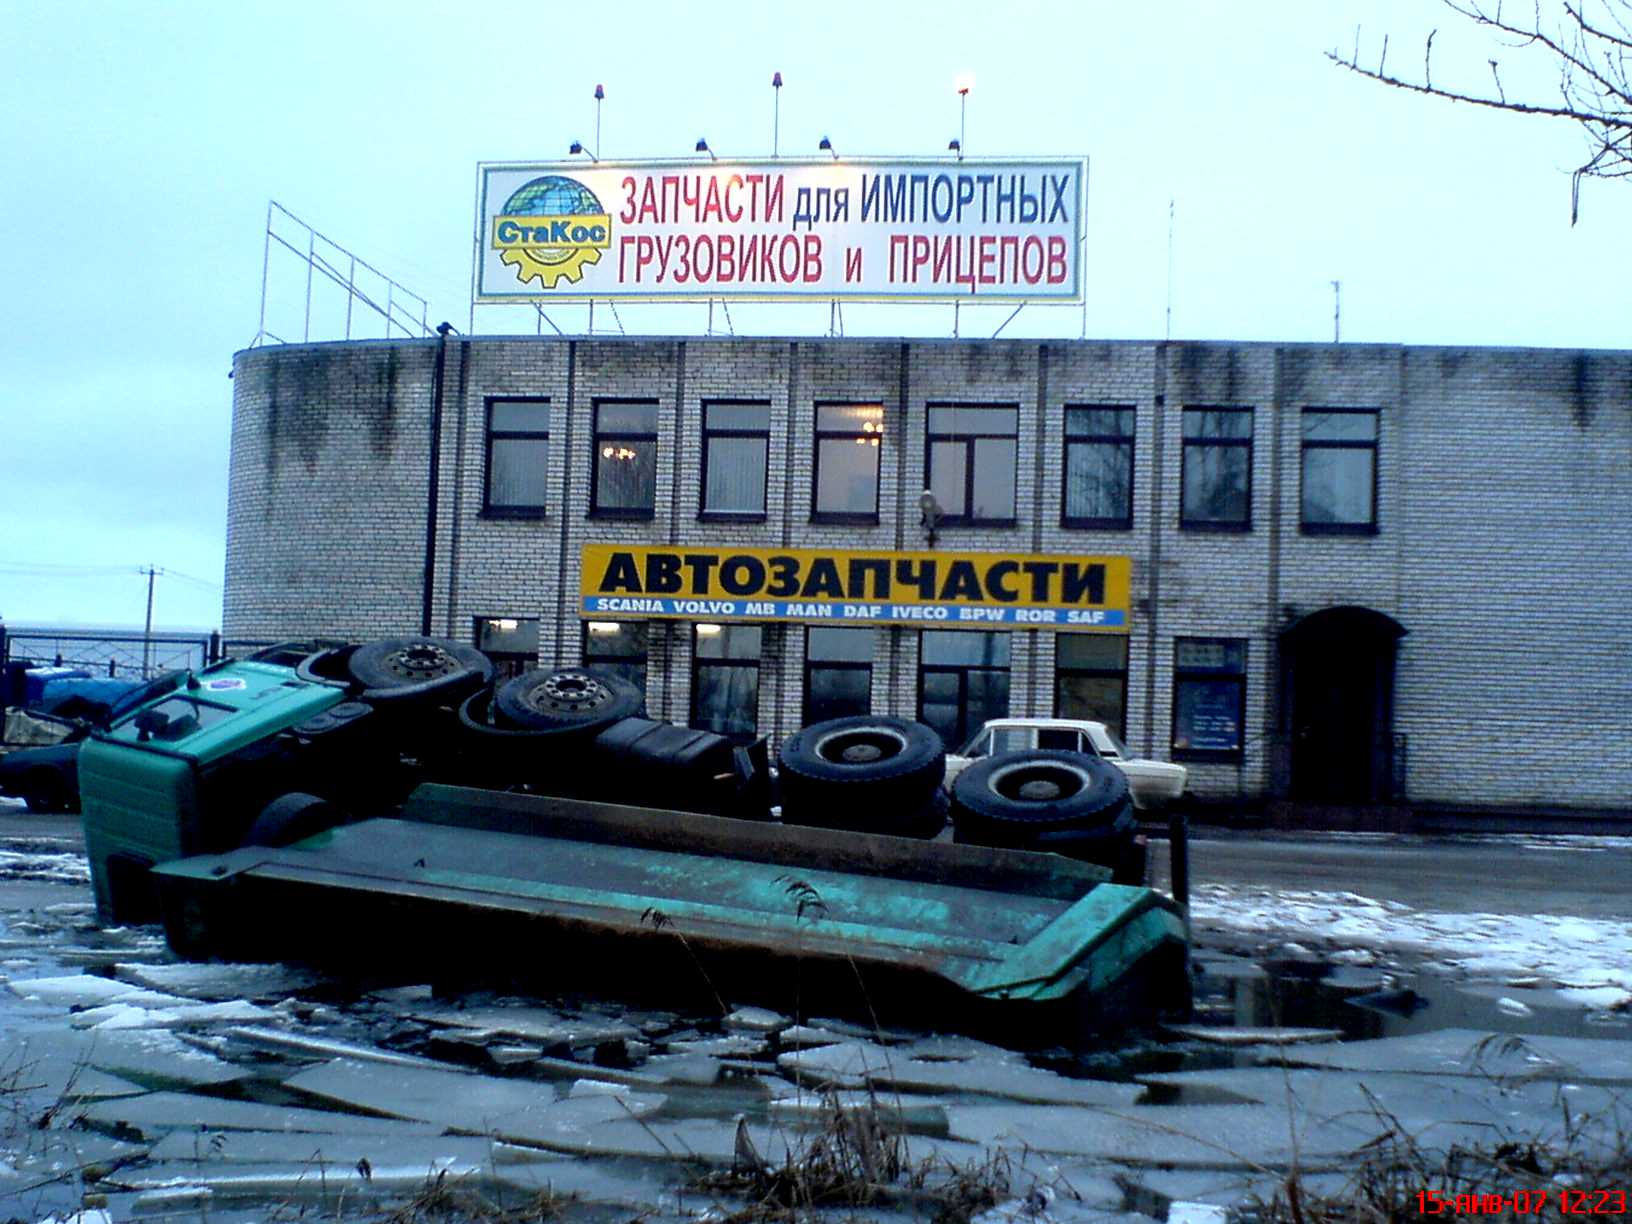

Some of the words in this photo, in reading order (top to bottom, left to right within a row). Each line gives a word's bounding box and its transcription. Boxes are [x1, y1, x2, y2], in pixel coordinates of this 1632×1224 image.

[620, 174, 783, 224] ЗАПЧАСТИ
[794, 187, 849, 231] для
[860, 173, 1069, 224] ИМПОРТНЫХ
[497, 220, 606, 243] СтаКос
[618, 235, 822, 284] ГРУЗОВИКОВ
[846, 247, 862, 283] и
[889, 235, 1067, 292] ПРИЦЕПОВ
[599, 552, 1106, 604] АВТОЗАПЧАСТИ
[597, 598, 664, 613] SCANIA
[673, 600, 735, 615] VOLVO
[745, 602, 776, 616] MB
[786, 603, 832, 618] MAN
[843, 605, 882, 619] DAF
[892, 606, 948, 620] IVECO
[959, 608, 1005, 622] BPW
[1015, 609, 1056, 623] ROR
[1067, 610, 1105, 624] SAF
